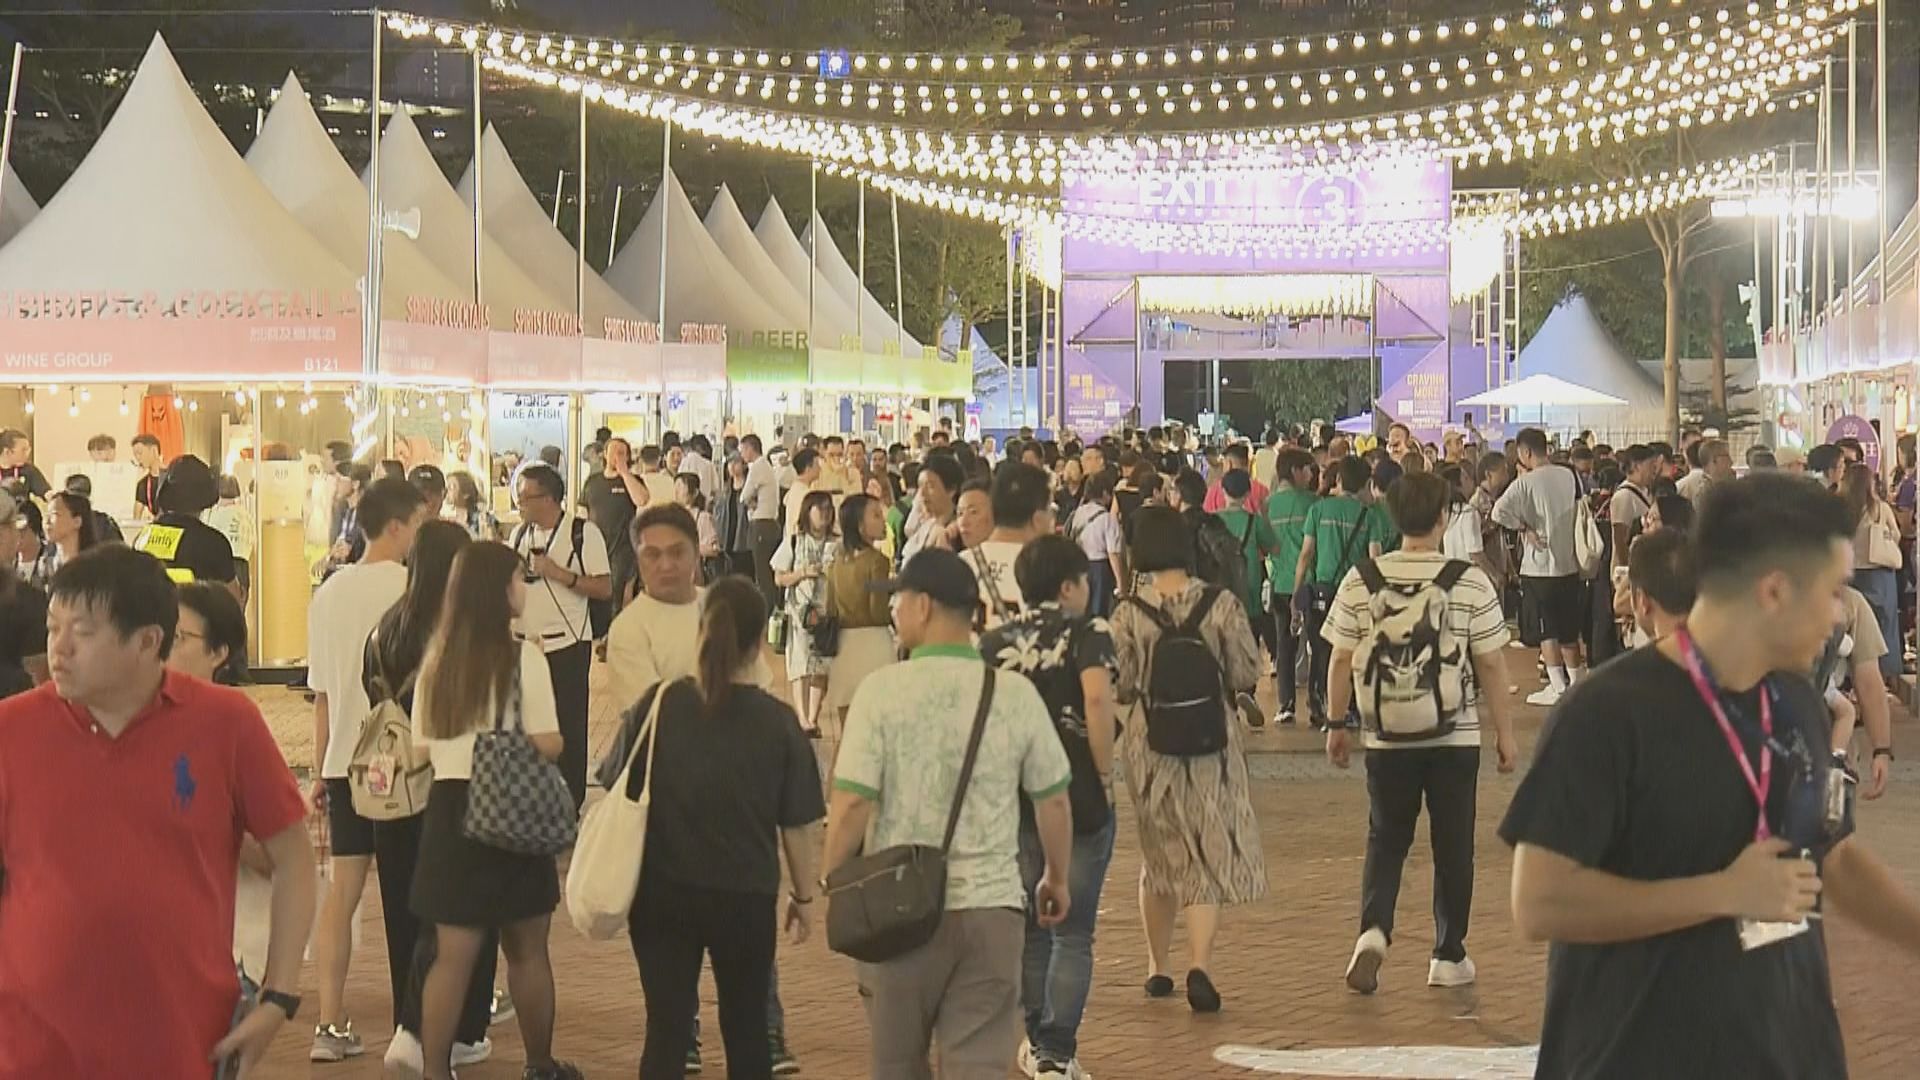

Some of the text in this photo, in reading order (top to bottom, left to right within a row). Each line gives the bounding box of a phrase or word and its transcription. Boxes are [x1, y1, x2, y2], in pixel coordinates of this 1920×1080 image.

[1140, 169, 1227, 206] EXIT
[1320, 185, 1346, 226] 3
[407, 296, 439, 327] SPIRITS
[447, 301, 490, 331] COCKTAILS
[513, 307, 541, 336] SPIRITS
[548, 311, 584, 338] COCKTAILS
[752, 329, 809, 351] BEER
[5, 352, 113, 368] WINE GROUP
[303, 357, 339, 372] B121
[503, 408, 561, 420] LIKE A FISH
